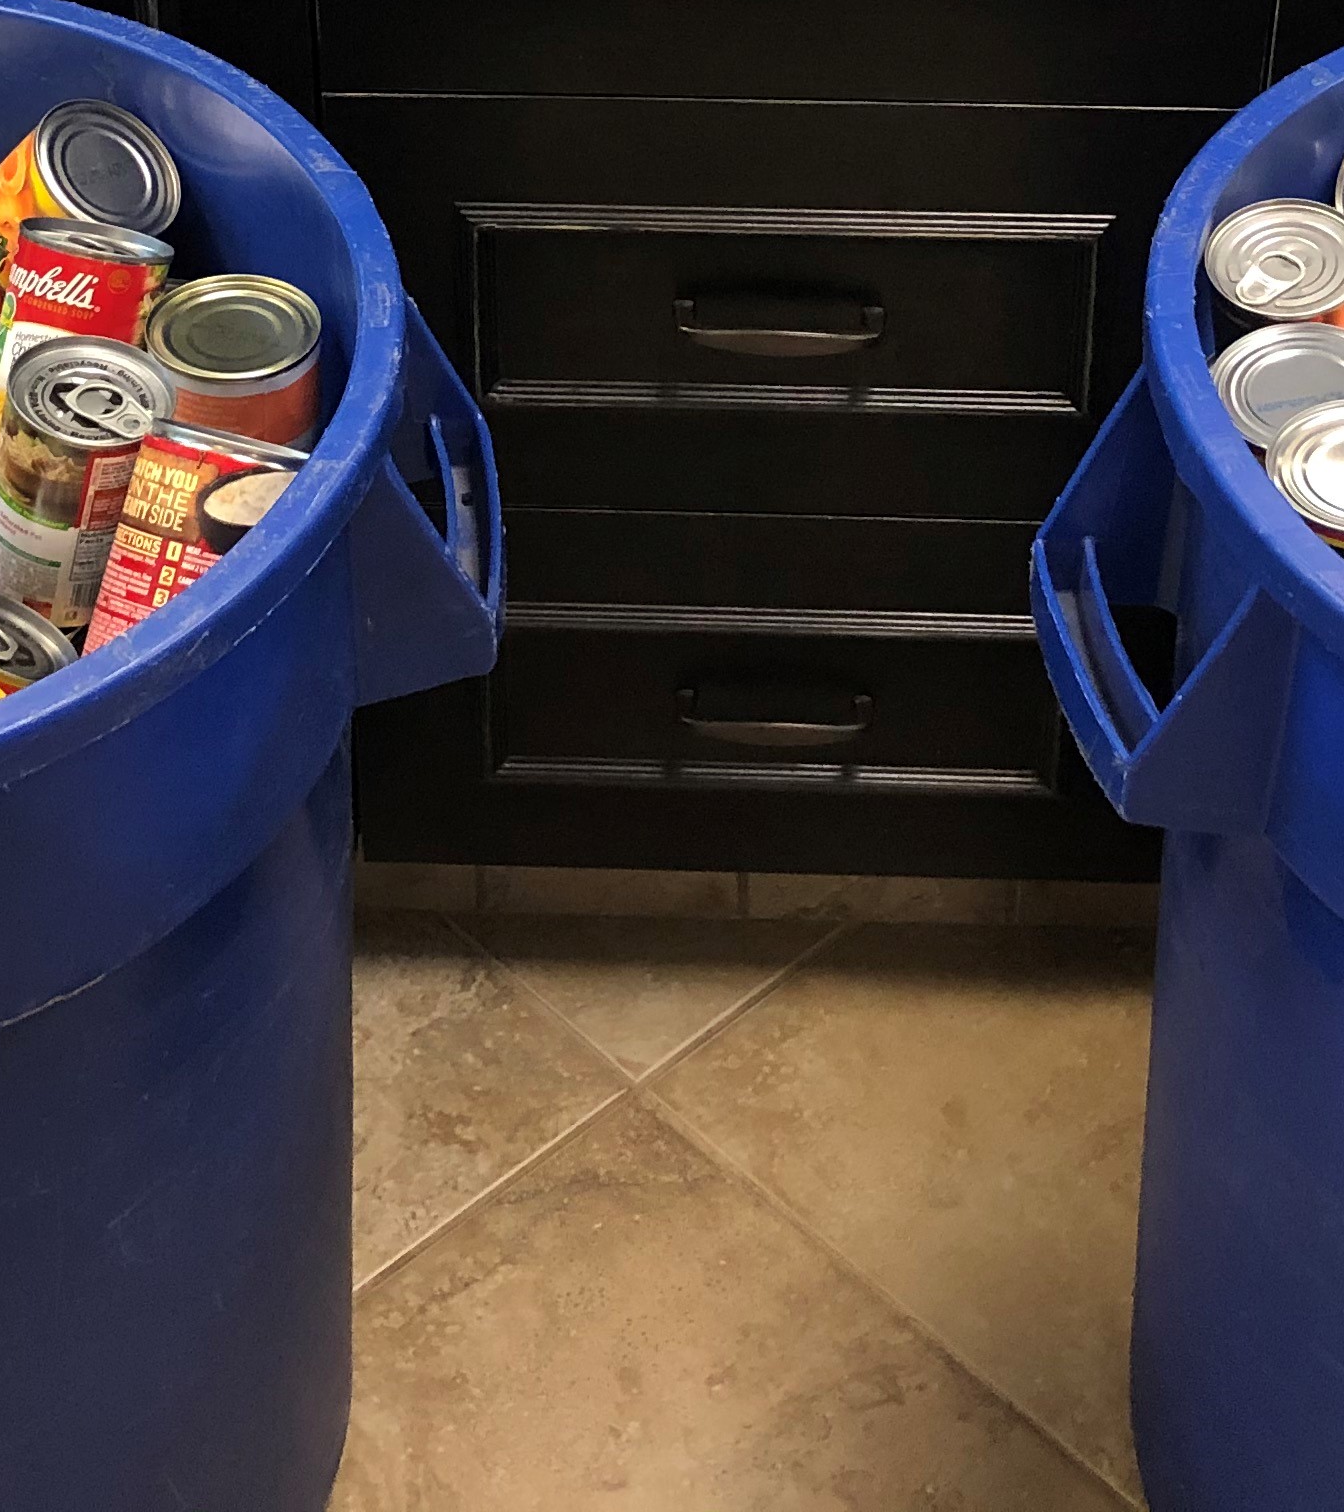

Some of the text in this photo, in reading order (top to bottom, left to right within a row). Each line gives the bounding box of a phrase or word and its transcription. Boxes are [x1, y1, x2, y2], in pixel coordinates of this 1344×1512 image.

[166, 466, 199, 494] YOU
[151, 483, 192, 510] THE
[153, 505, 189, 533] SIDE
